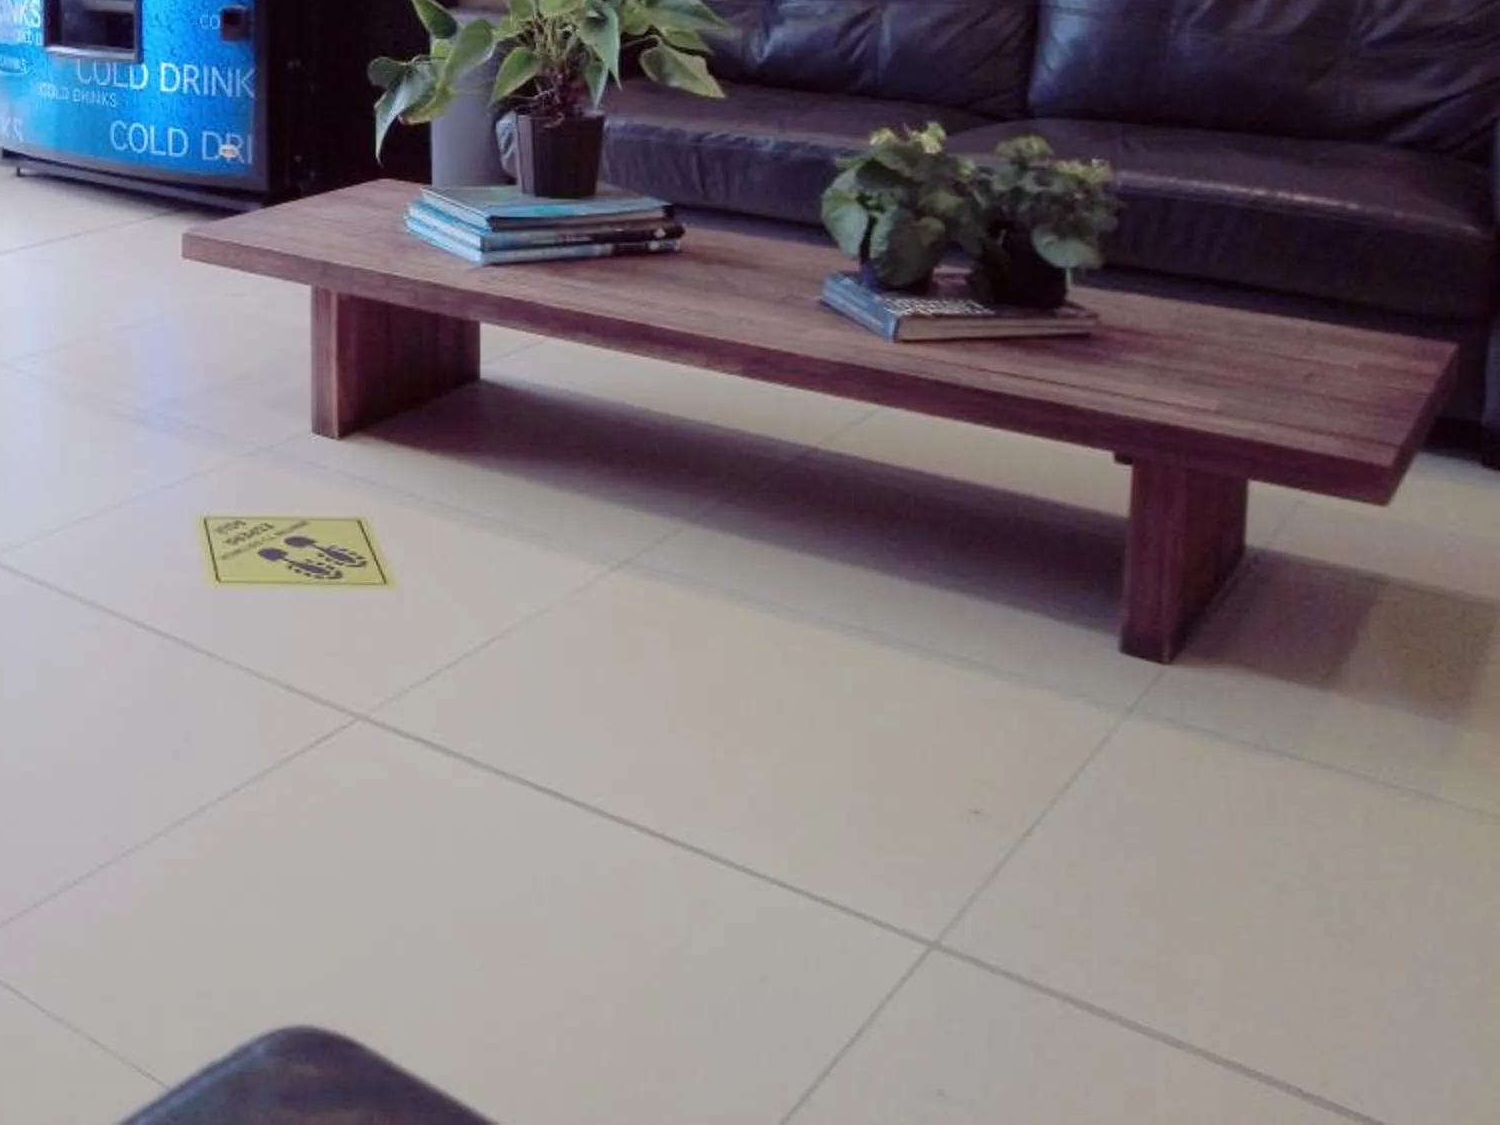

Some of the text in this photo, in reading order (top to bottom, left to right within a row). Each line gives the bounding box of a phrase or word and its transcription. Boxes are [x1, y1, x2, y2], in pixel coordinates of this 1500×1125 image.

[77, 59, 149, 89] COLD
[72, 88, 117, 108] DRINKS
[110, 120, 189, 157] COLD
